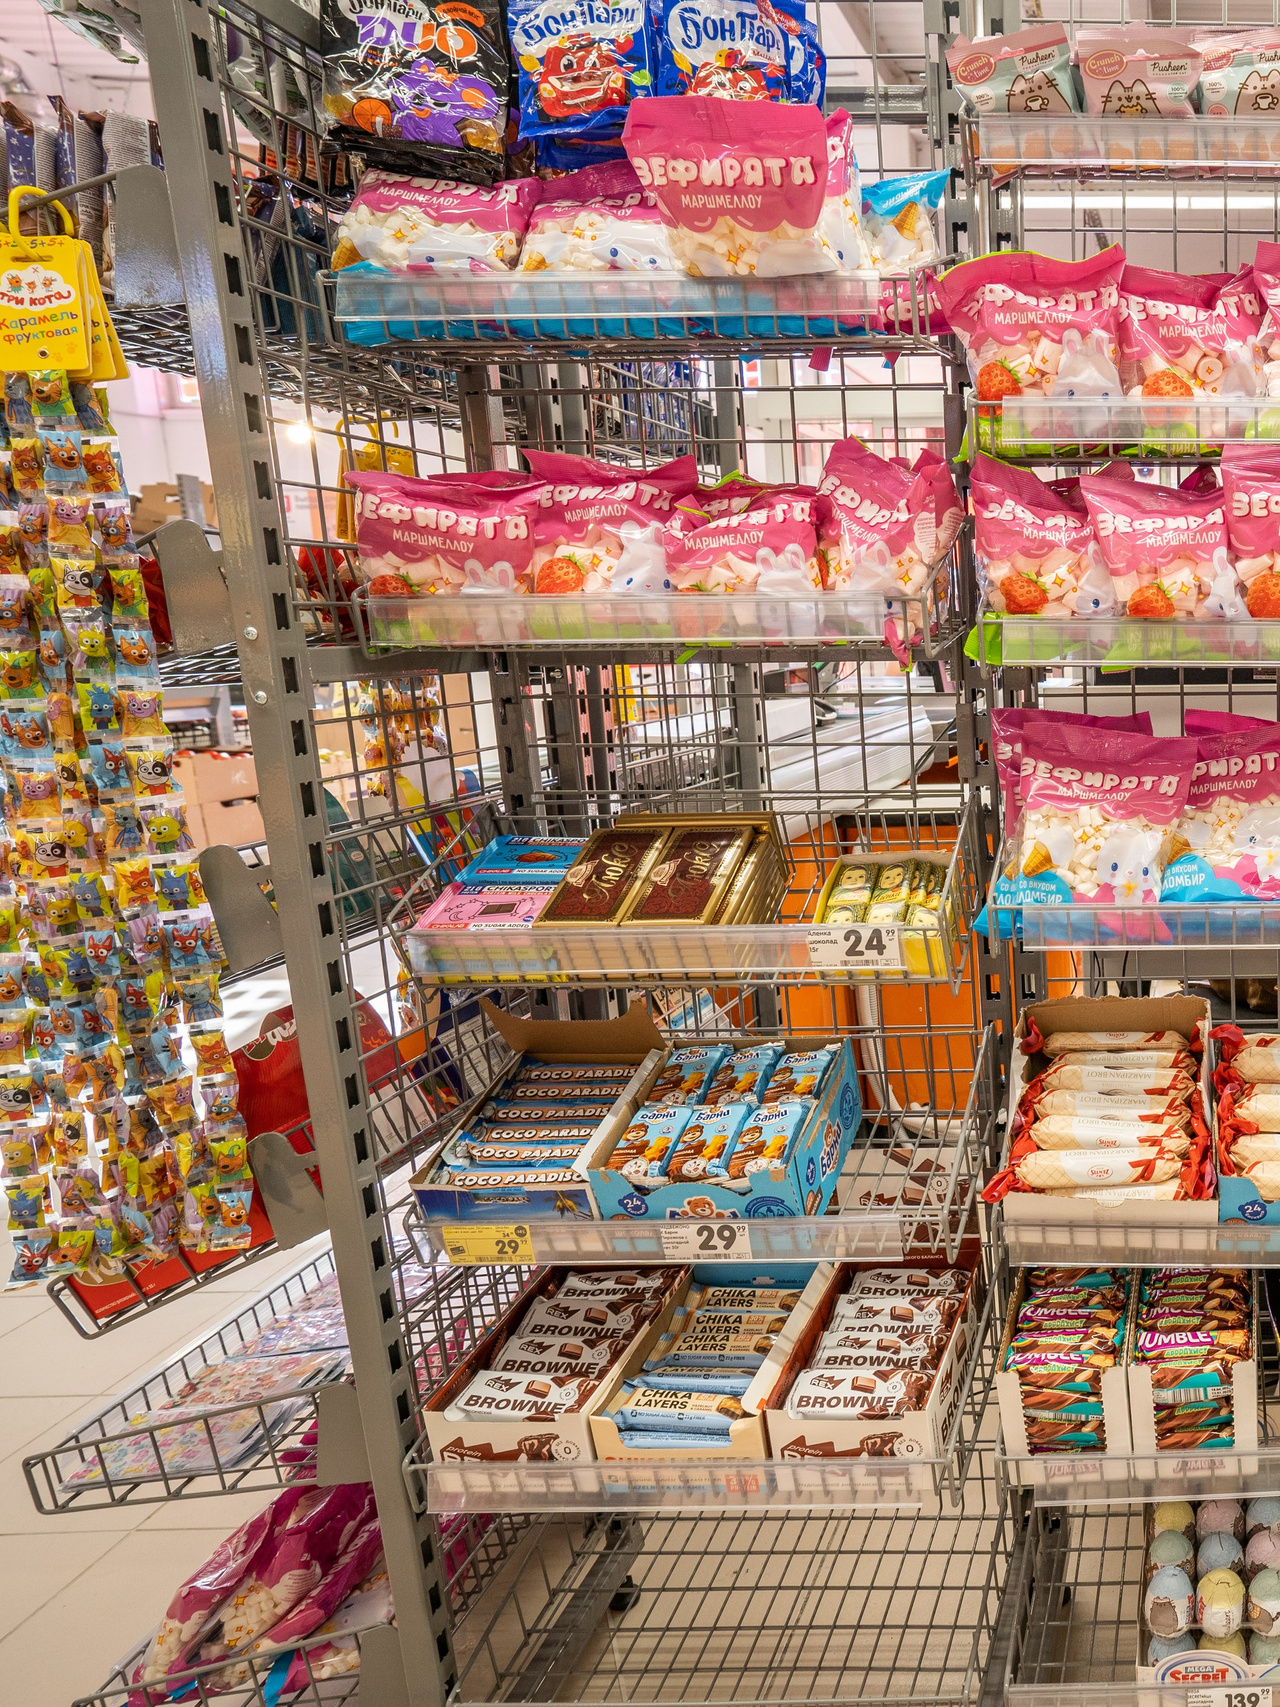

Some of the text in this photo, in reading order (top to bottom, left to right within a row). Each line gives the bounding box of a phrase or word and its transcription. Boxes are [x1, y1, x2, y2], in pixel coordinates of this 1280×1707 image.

[356, 14, 478, 59] DUO
[960, 55, 989, 76] Crunch
[1019, 51, 1055, 66] Pusheen
[1089, 54, 1121, 69] Crunch
[1151, 62, 1188, 74] Pusheen
[632, 155, 816, 188] ЗЕФИРЯТА
[377, 186, 461, 207] МАРШМЕЛЛОУ
[681, 193, 762, 210] МАРШМЕЛЛОУ
[30, 290, 71, 307] КОТА
[994, 311, 1073, 326] МАРШМЕЛЛОУ
[3, 325, 78, 344] Фруктовая
[1159, 323, 1228, 339] МАРШМЕЛЛОУ
[393, 530, 474, 553] МАРШМЕЛЛОУ
[684, 530, 764, 551] МАРШМЕЛЛОУ
[1021, 757, 1180, 797] ЗЕФИРЯТА
[1171, 864, 1198, 875] ВКУСОМ
[1019, 881, 1057, 892] СО ВКУСОМ
[843, 928, 887, 957] 24
[674, 1051, 709, 1063] Барни
[785, 1053, 818, 1065] Барни
[530, 1068, 638, 1080] COCO PARADIS
[1086, 1071, 1152, 1080] MARZIPAN BROT
[515, 1086, 625, 1098] COCO PARADIS
[498, 1107, 610, 1120] COCO PARADIS
[695, 1109, 731, 1122] Барни
[753, 1109, 788, 1123] Барни
[454, 1175, 502, 1187] COCO
[623, 1197, 641, 1209] 24
[697, 1224, 737, 1252] 29
[495, 1239, 520, 1256] 29
[711, 1289, 757, 1299] CHIKA
[859, 1286, 948, 1297] BROWNIE
[706, 1298, 754, 1309] LAYERS
[547, 1309, 568, 1320] REX
[529, 1323, 624, 1339] BROWNIE
[487, 1380, 508, 1392] REX
[811, 1379, 834, 1391] REX
[641, 1389, 693, 1401] CHIKA
[464, 1394, 566, 1413] BROWNIE
[634, 1398, 689, 1410] LAYERS
[796, 1395, 896, 1410] BROWNIE
[787, 1444, 823, 1457] protein
[1169, 1668, 1230, 1682] SECRET
[1225, 1692, 1260, 1707] 139
